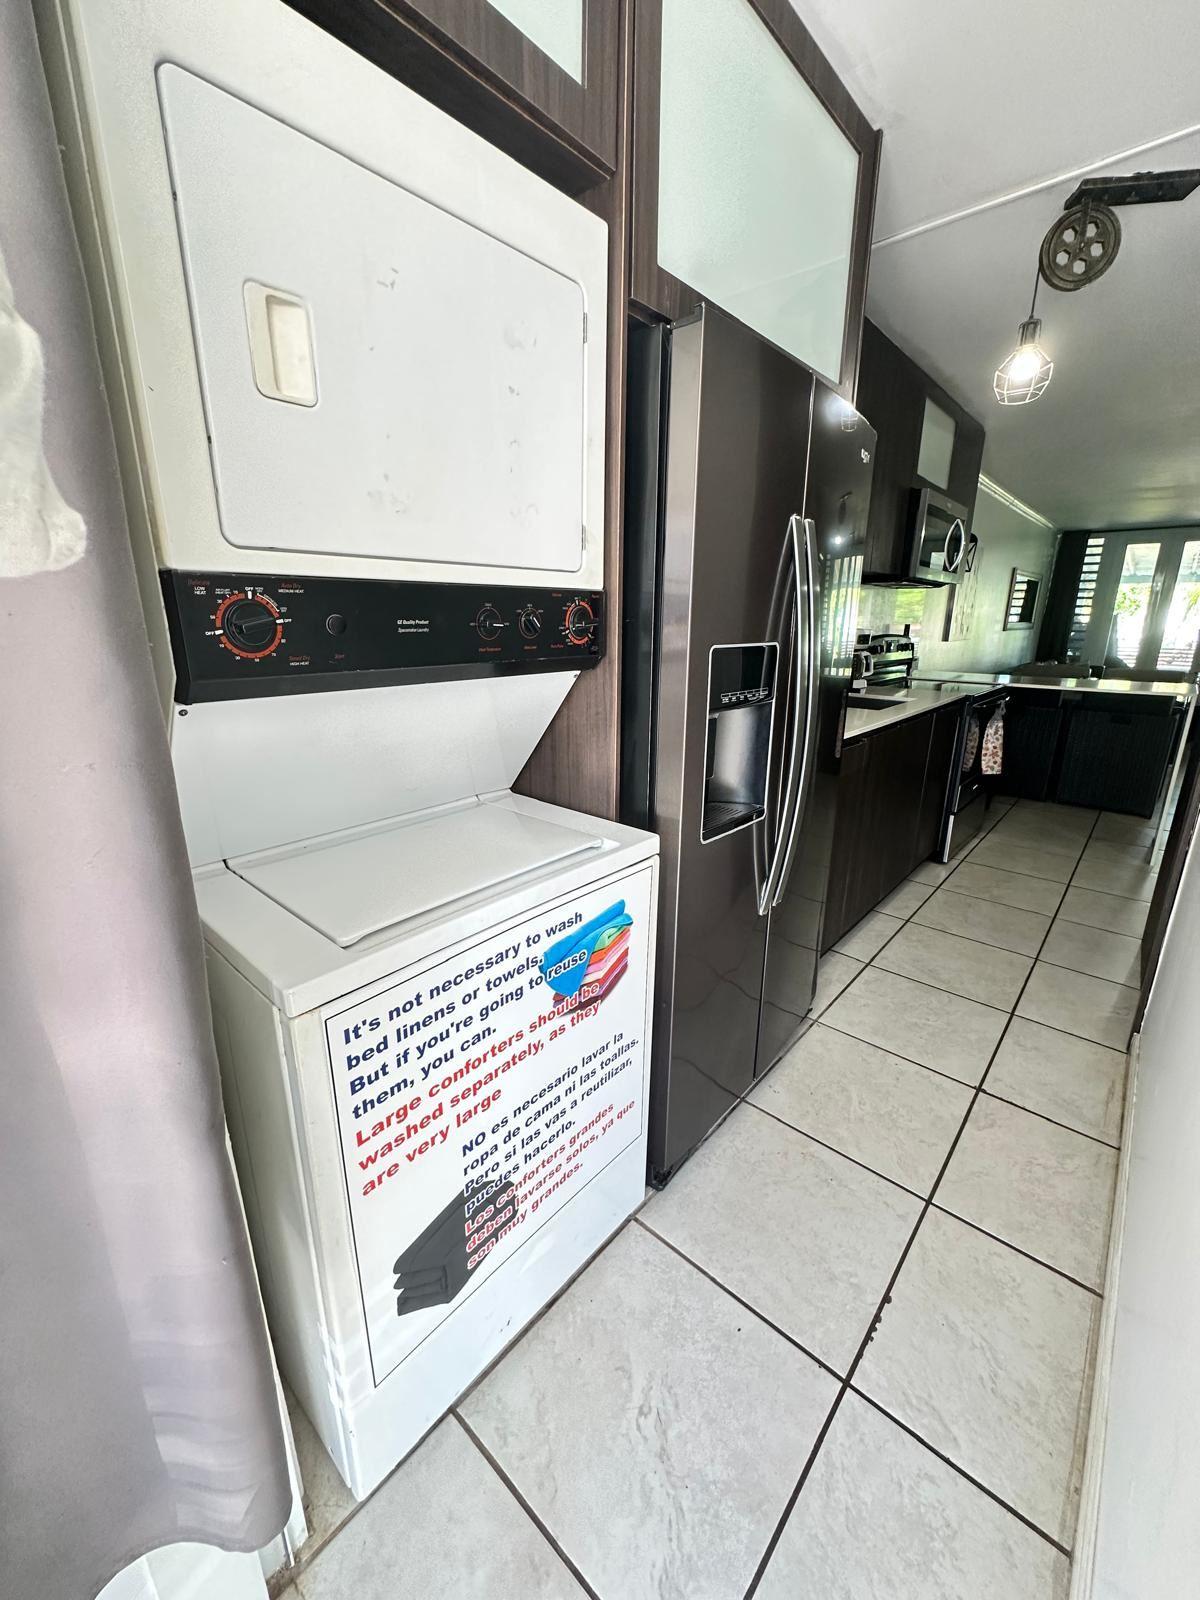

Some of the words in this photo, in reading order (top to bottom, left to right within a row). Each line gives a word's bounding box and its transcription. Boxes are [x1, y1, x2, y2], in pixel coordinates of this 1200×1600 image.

[343, 1017, 381, 1045] It's
[389, 994, 423, 1022] not
[430, 939, 521, 999] necessary
[526, 933, 541, 948] to
[546, 912, 583, 938] wash
[346, 1038, 389, 1070] bed
[397, 1004, 455, 1043] linens
[462, 989, 480, 1005] or
[486, 955, 543, 992] towels.
[350, 1063, 389, 1095] But
[397, 1048, 409, 1065] if
[416, 1013, 473, 1059] you're
[480, 986, 524, 1020] going
[529, 975, 544, 990] to
[548, 950, 587, 980] reuse
[352, 1079, 415, 1119] them,
[421, 1050, 454, 1079] you
[461, 1028, 497, 1052] can.
[356, 1096, 422, 1147] Large
[430, 1031, 523, 1098] conforters
[530, 995, 577, 1033] should
[582, 983, 599, 1002] be
[359, 1106, 443, 1170] washed
[450, 1040, 544, 1113] separately,
[549, 1025, 566, 1041] as
[570, 1001, 600, 1029] they
[462, 1132, 486, 1157] NO
[492, 1117, 508, 1134] es
[513, 1066, 578, 1117] necesario
[582, 1042, 610, 1068] lavar
[614, 1032, 623, 1044] la
[463, 1144, 498, 1176] ropa
[503, 1129, 520, 1145] de
[525, 1096, 561, 1127] cama
[565, 1084, 576, 1097] ni
[580, 1067, 596, 1085] las
[601, 1039, 639, 1071] toallas.
[464, 1162, 500, 1195] Pero
[505, 1147, 516, 1162] si
[521, 1128, 541, 1150] las
[544, 1107, 566, 1128] vas
[570, 1100, 578, 1109] a
[581, 1060, 632, 1102] reutilizar,
[362, 1162, 400, 1196] are
[407, 1124, 450, 1163] very
[456, 1089, 502, 1128] large
[465, 1206, 493, 1235] Los
[497, 1143, 566, 1207] conforters
[569, 1104, 614, 1147] grandes
[466, 1163, 520, 1215] puedes
[524, 1120, 576, 1163] hacerlo.
[467, 1208, 512, 1252] deben
[515, 1160, 562, 1209] lavarse
[566, 1135, 599, 1163] solos,
[601, 1119, 614, 1136] ya
[617, 1100, 635, 1121] que
[468, 1240, 496, 1269] son
[498, 1211, 527, 1241] muy
[531, 1163, 583, 1212] grandes.
